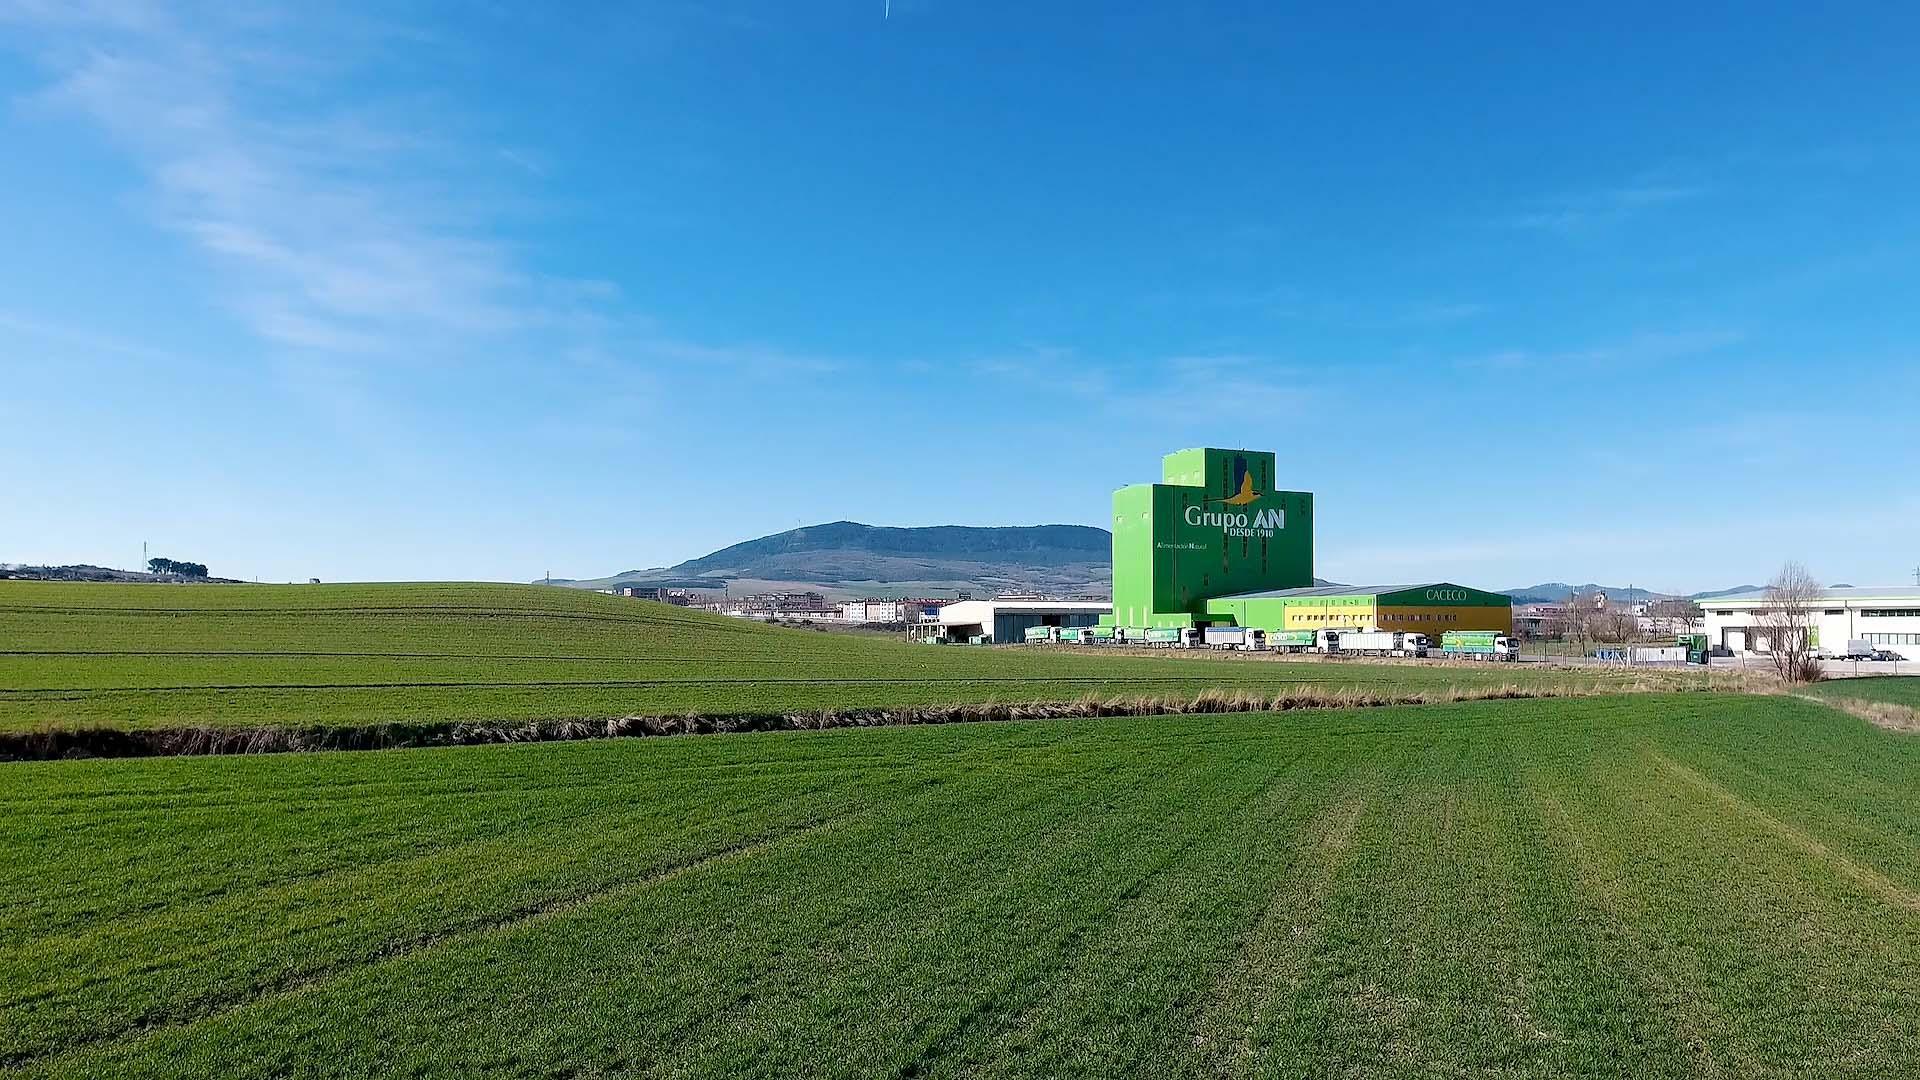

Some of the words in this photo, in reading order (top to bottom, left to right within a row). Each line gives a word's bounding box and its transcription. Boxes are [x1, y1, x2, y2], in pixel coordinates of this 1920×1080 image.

[1185, 505, 1248, 533] Grupo
[1252, 508, 1285, 529] AN
[1230, 528, 1255, 537] DESDE
[1257, 529, 1274, 538] 1910
[1426, 589, 1467, 601] CACECO
